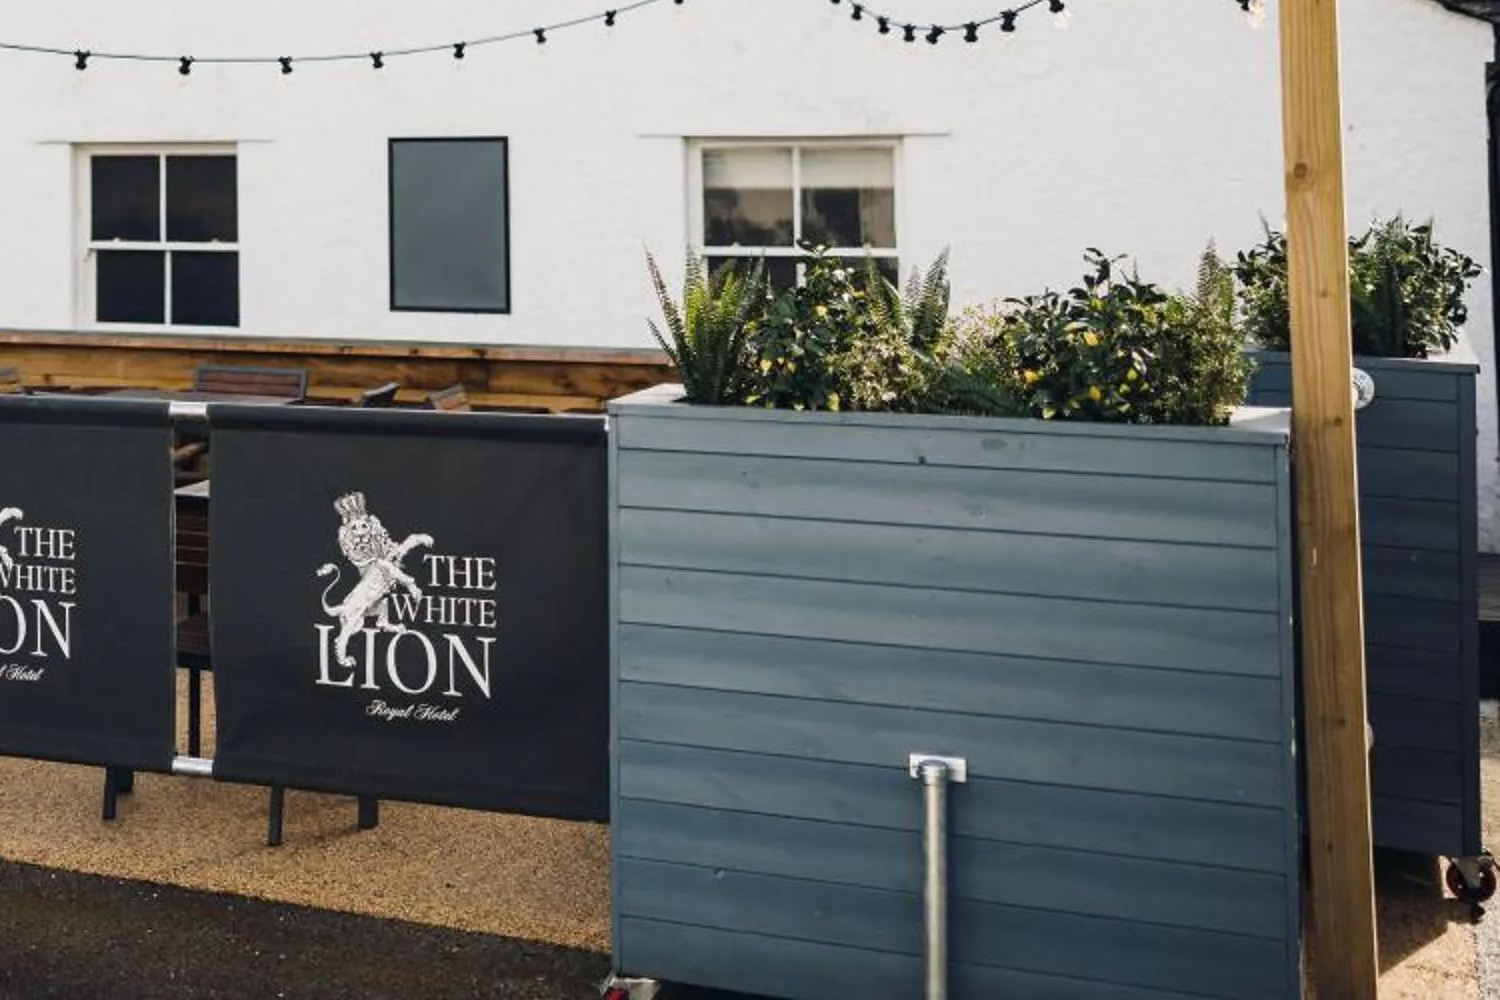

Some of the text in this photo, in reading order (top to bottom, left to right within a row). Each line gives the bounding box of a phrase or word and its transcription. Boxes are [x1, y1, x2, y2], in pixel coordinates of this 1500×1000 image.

[13, 526, 76, 560] THE
[422, 554, 497, 591] THE
[390, 593, 497, 629] WHITE
[6, 663, 45, 682] Hotel
[313, 623, 497, 699] LION
[365, 699, 461, 722] Royal Hotel
